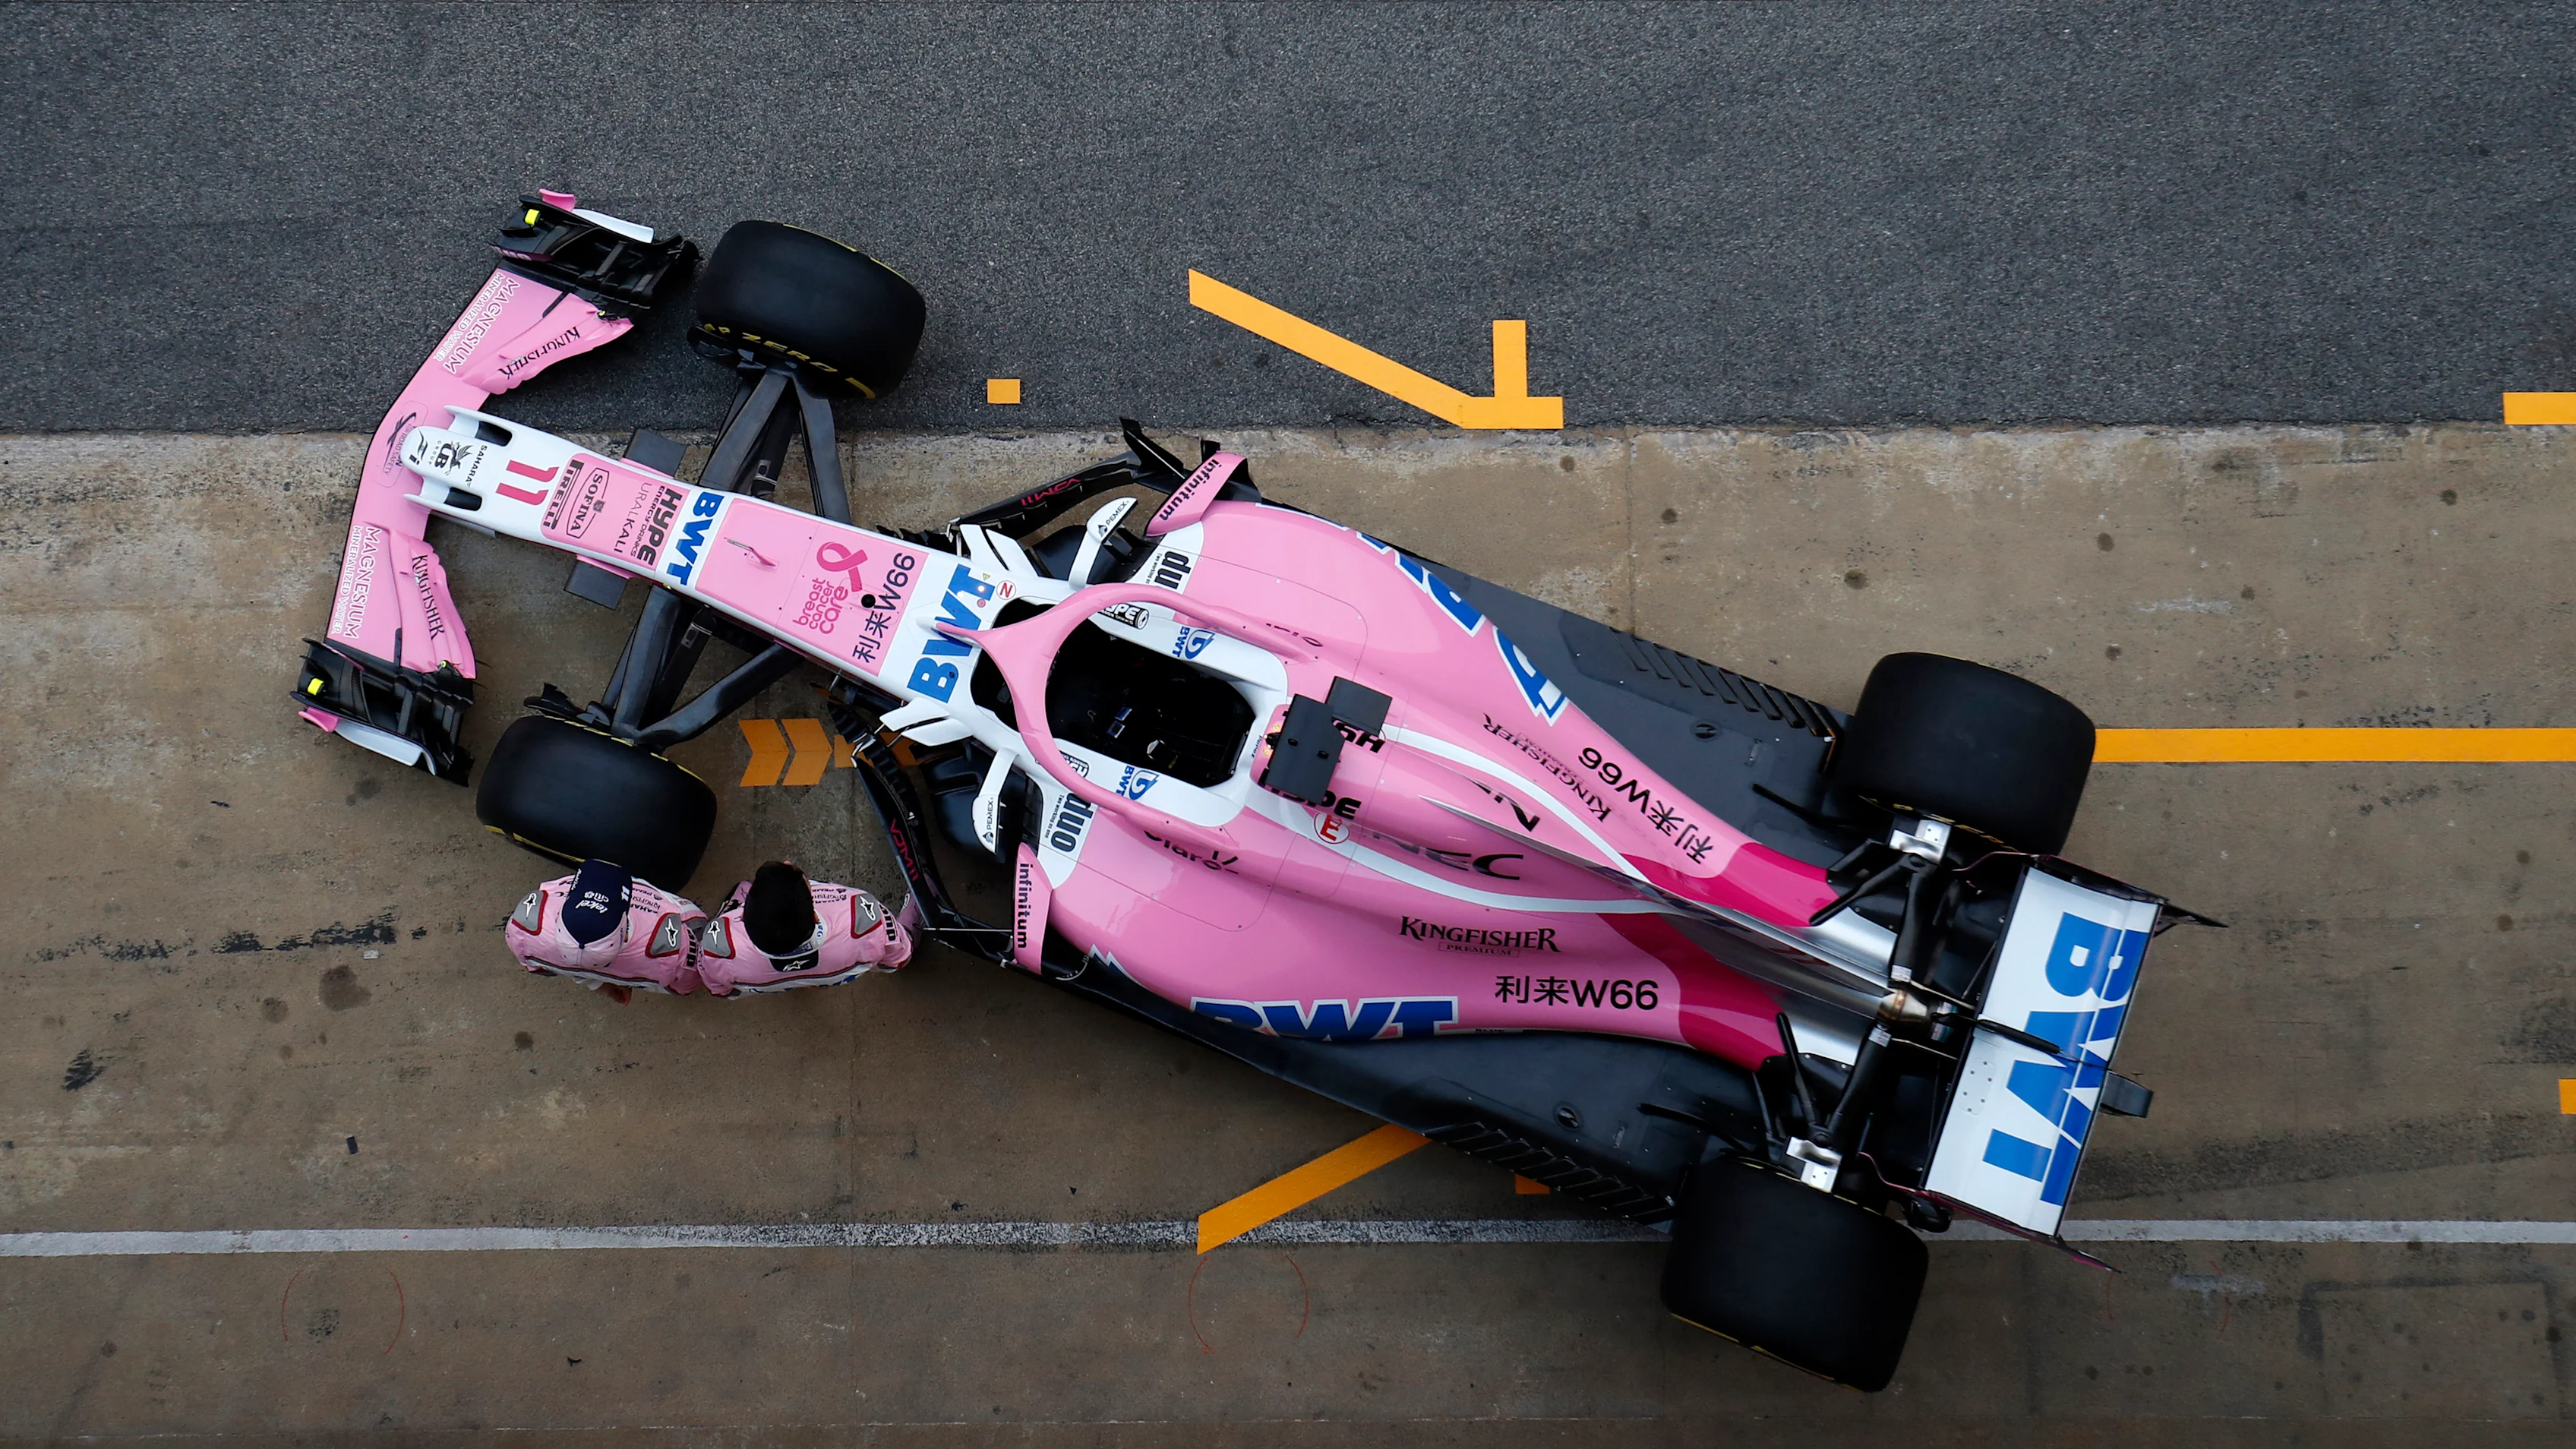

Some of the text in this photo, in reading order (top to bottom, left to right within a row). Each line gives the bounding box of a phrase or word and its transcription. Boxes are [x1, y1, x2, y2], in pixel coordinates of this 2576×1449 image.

[433, 271, 505, 363] MINERALIZED WATER
[442, 276, 521, 374] MAGNESIUM
[383, 450, 399, 475] SAFETY
[428, 440, 442, 466] GROUP
[434, 443, 453, 469] UB
[466, 444, 488, 486] SAHARA
[496, 459, 559, 506] 11
[542, 459, 585, 530] PIRELLI
[571, 472, 604, 532] SOFINA
[1158, 459, 1223, 521] infinitum
[614, 481, 652, 554] URALKALI
[636, 488, 683, 566] HYPE
[1105, 500, 1130, 526] PEMEX
[667, 491, 725, 586] BWT
[330, 526, 363, 634] MINERALIZED WATER
[344, 526, 383, 639] MAGNESIUM
[999, 582, 1015, 598] N
[1154, 550, 1190, 590] du
[412, 554, 447, 640] KINGFISHER
[792, 577, 829, 627] breast
[809, 582, 836, 630] cancer
[819, 586, 848, 635] care
[852, 552, 915, 663] 利来W66
[907, 563, 996, 703] BWT
[1172, 626, 1192, 658] BWT
[1482, 712, 1612, 822] KINGFISHER
[1320, 814, 1340, 841] E
[1577, 745, 1716, 866] 利来W66
[575, 899, 608, 914] telcel
[1016, 863, 1034, 949] infinitum
[1397, 914, 1562, 955] KINGFISHER
[1444, 942, 1514, 958] PREMIUM
[1494, 975, 1659, 1011] 利来W66
[1192, 996, 1458, 1041] BWT
[1981, 911, 2152, 1208] BWT
